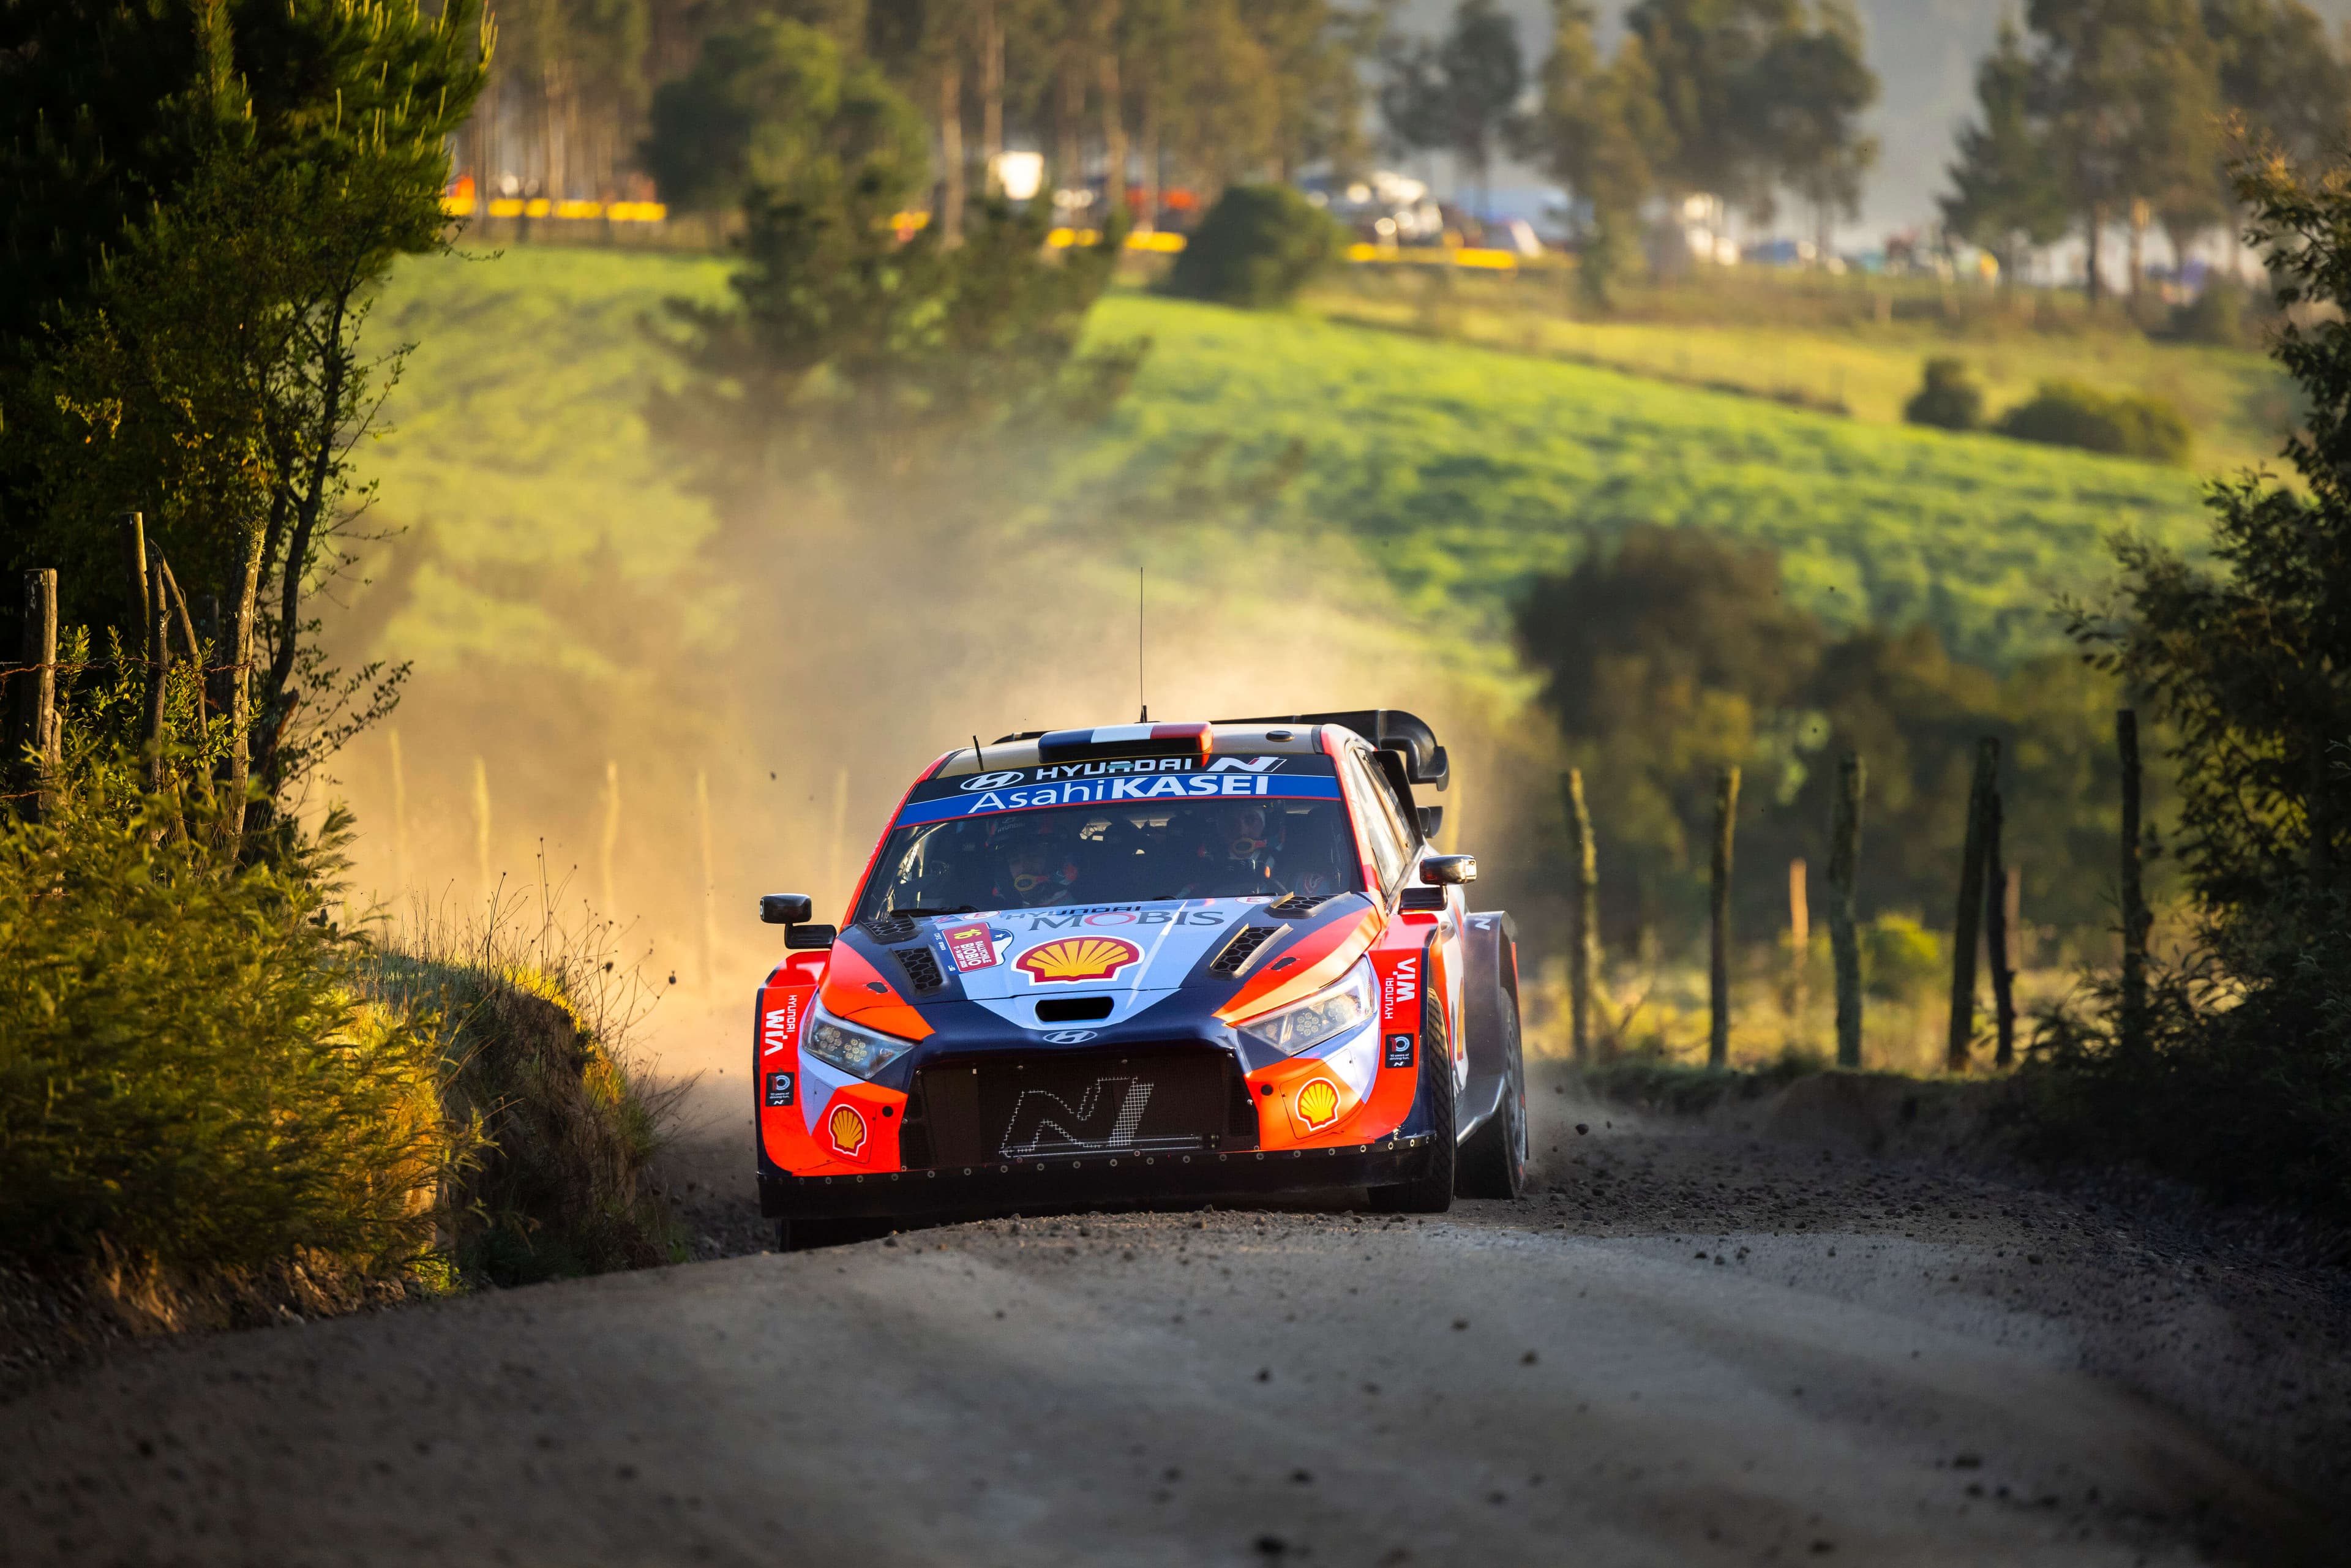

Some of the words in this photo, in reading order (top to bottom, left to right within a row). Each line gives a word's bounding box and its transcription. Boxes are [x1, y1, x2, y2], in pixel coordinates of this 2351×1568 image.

[1036, 758, 1192, 779] HYUNDAI
[1006, 906, 1141, 919] HYUNDAI
[1027, 912, 1225, 931] MOBIS
[1384, 978, 1394, 1019] HYUNDAI
[787, 995, 797, 1032] HYUNDAI
